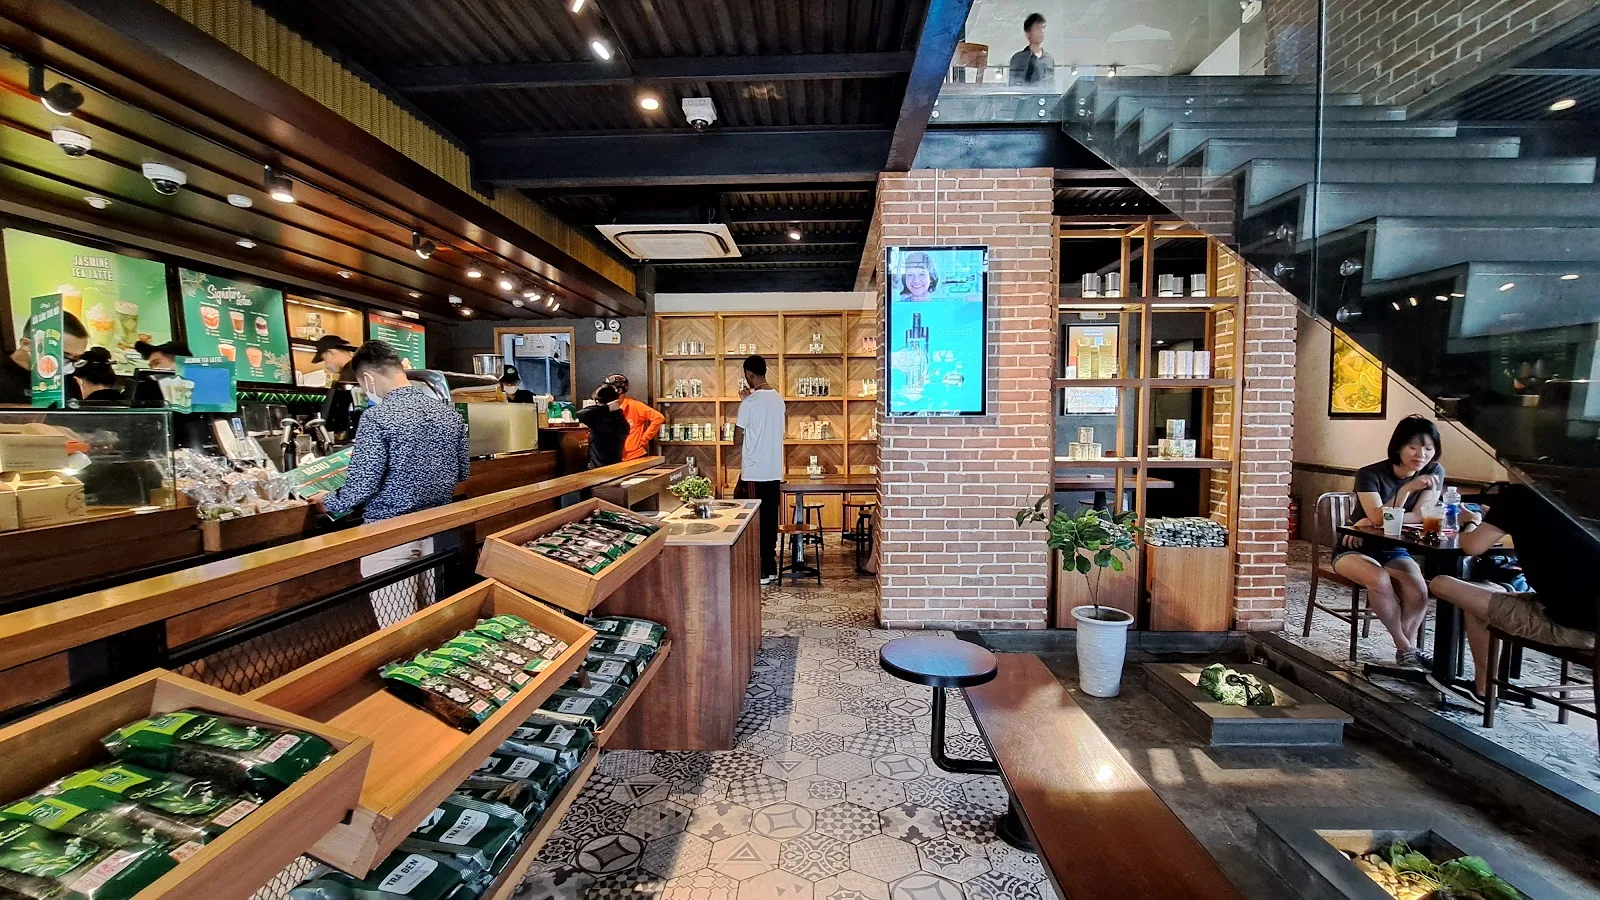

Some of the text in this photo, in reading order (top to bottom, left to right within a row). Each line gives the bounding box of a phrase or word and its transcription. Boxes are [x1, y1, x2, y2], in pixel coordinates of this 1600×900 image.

[73, 255, 110, 269] JASMINE
[72, 267, 113, 281] TEA LATTE
[206, 284, 241, 305] Signature
[302, 461, 331, 476] MENU
